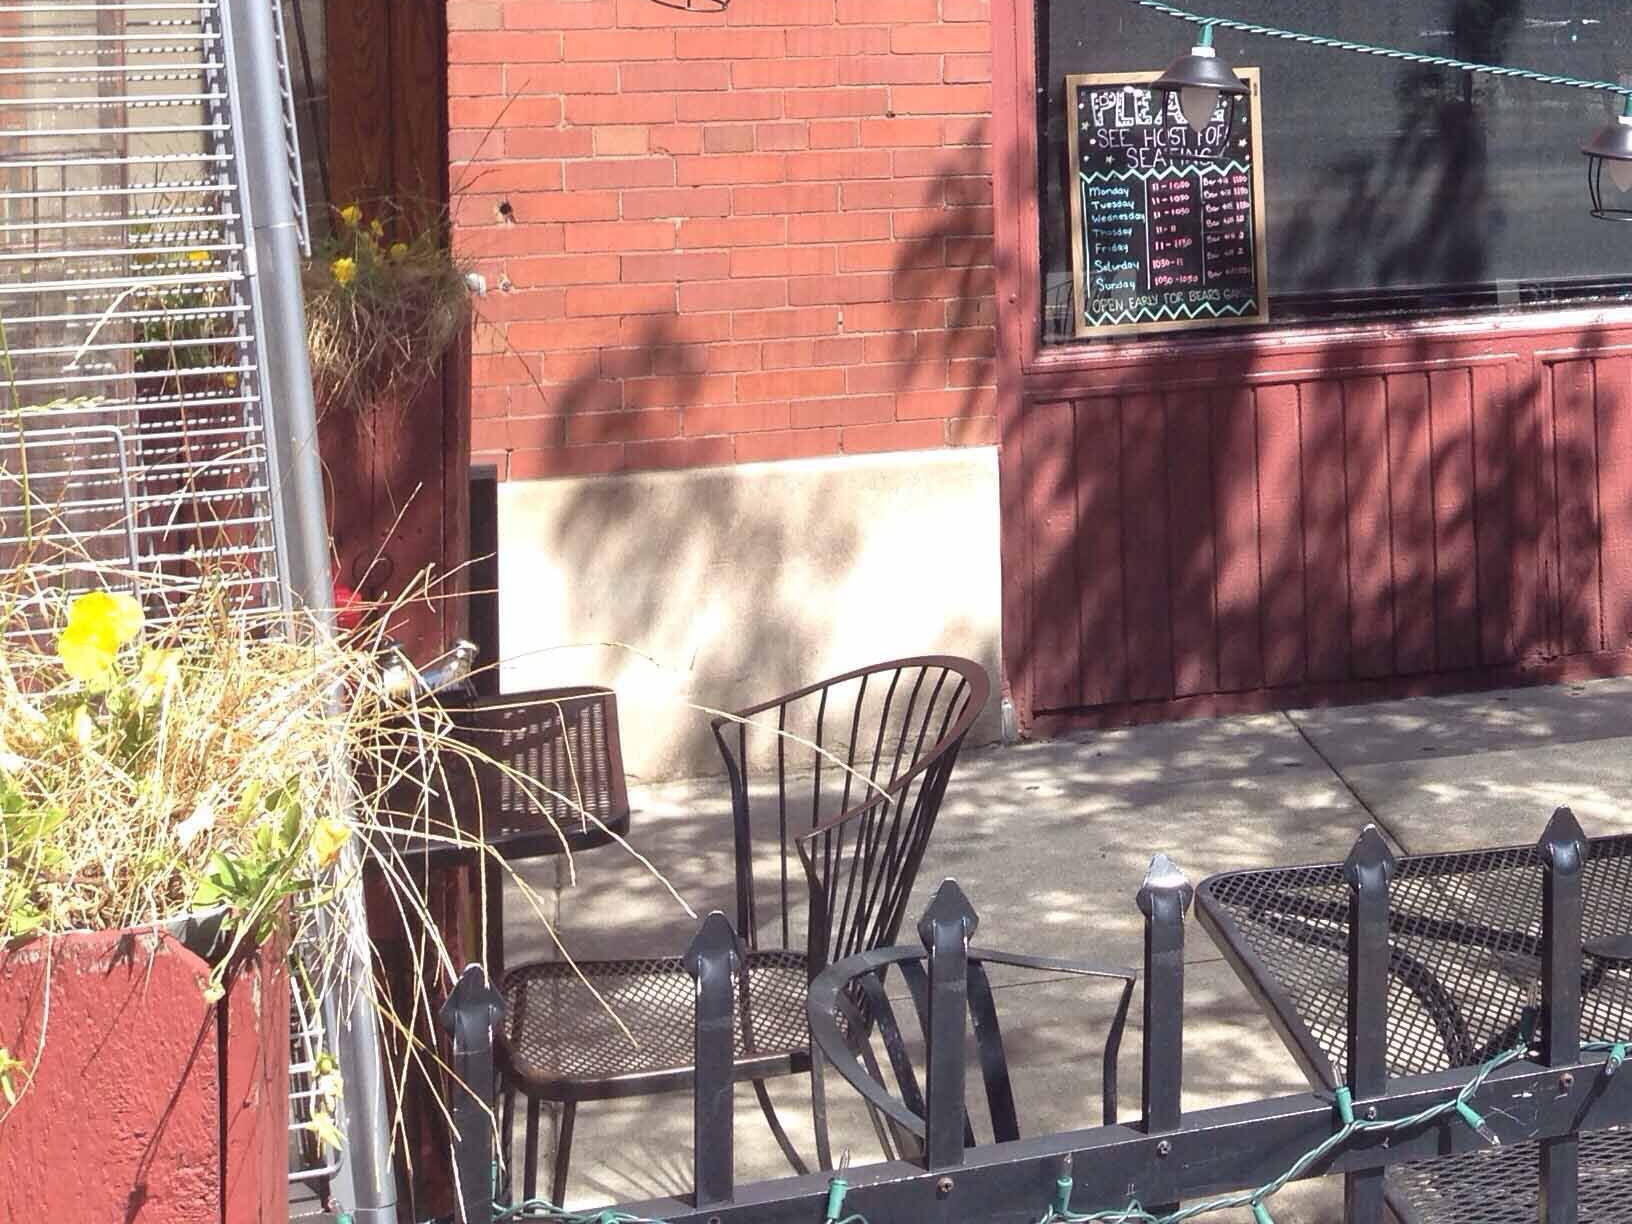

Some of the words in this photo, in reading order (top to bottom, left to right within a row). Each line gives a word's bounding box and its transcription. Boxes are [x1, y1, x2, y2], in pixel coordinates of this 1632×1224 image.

[1097, 128, 1134, 149] SEE
[1143, 126, 1188, 148] HOST
[1089, 186, 1130, 197] Monday
[1091, 200, 1135, 211] Tuesday
[1095, 242, 1129, 254] Friday
[1094, 259, 1140, 274] Saturday
[1095, 277, 1136, 292] Sunday
[1092, 297, 1124, 314] OPEN
[1128, 293, 1159, 310] EARLY
[1188, 288, 1221, 302] BEARS
